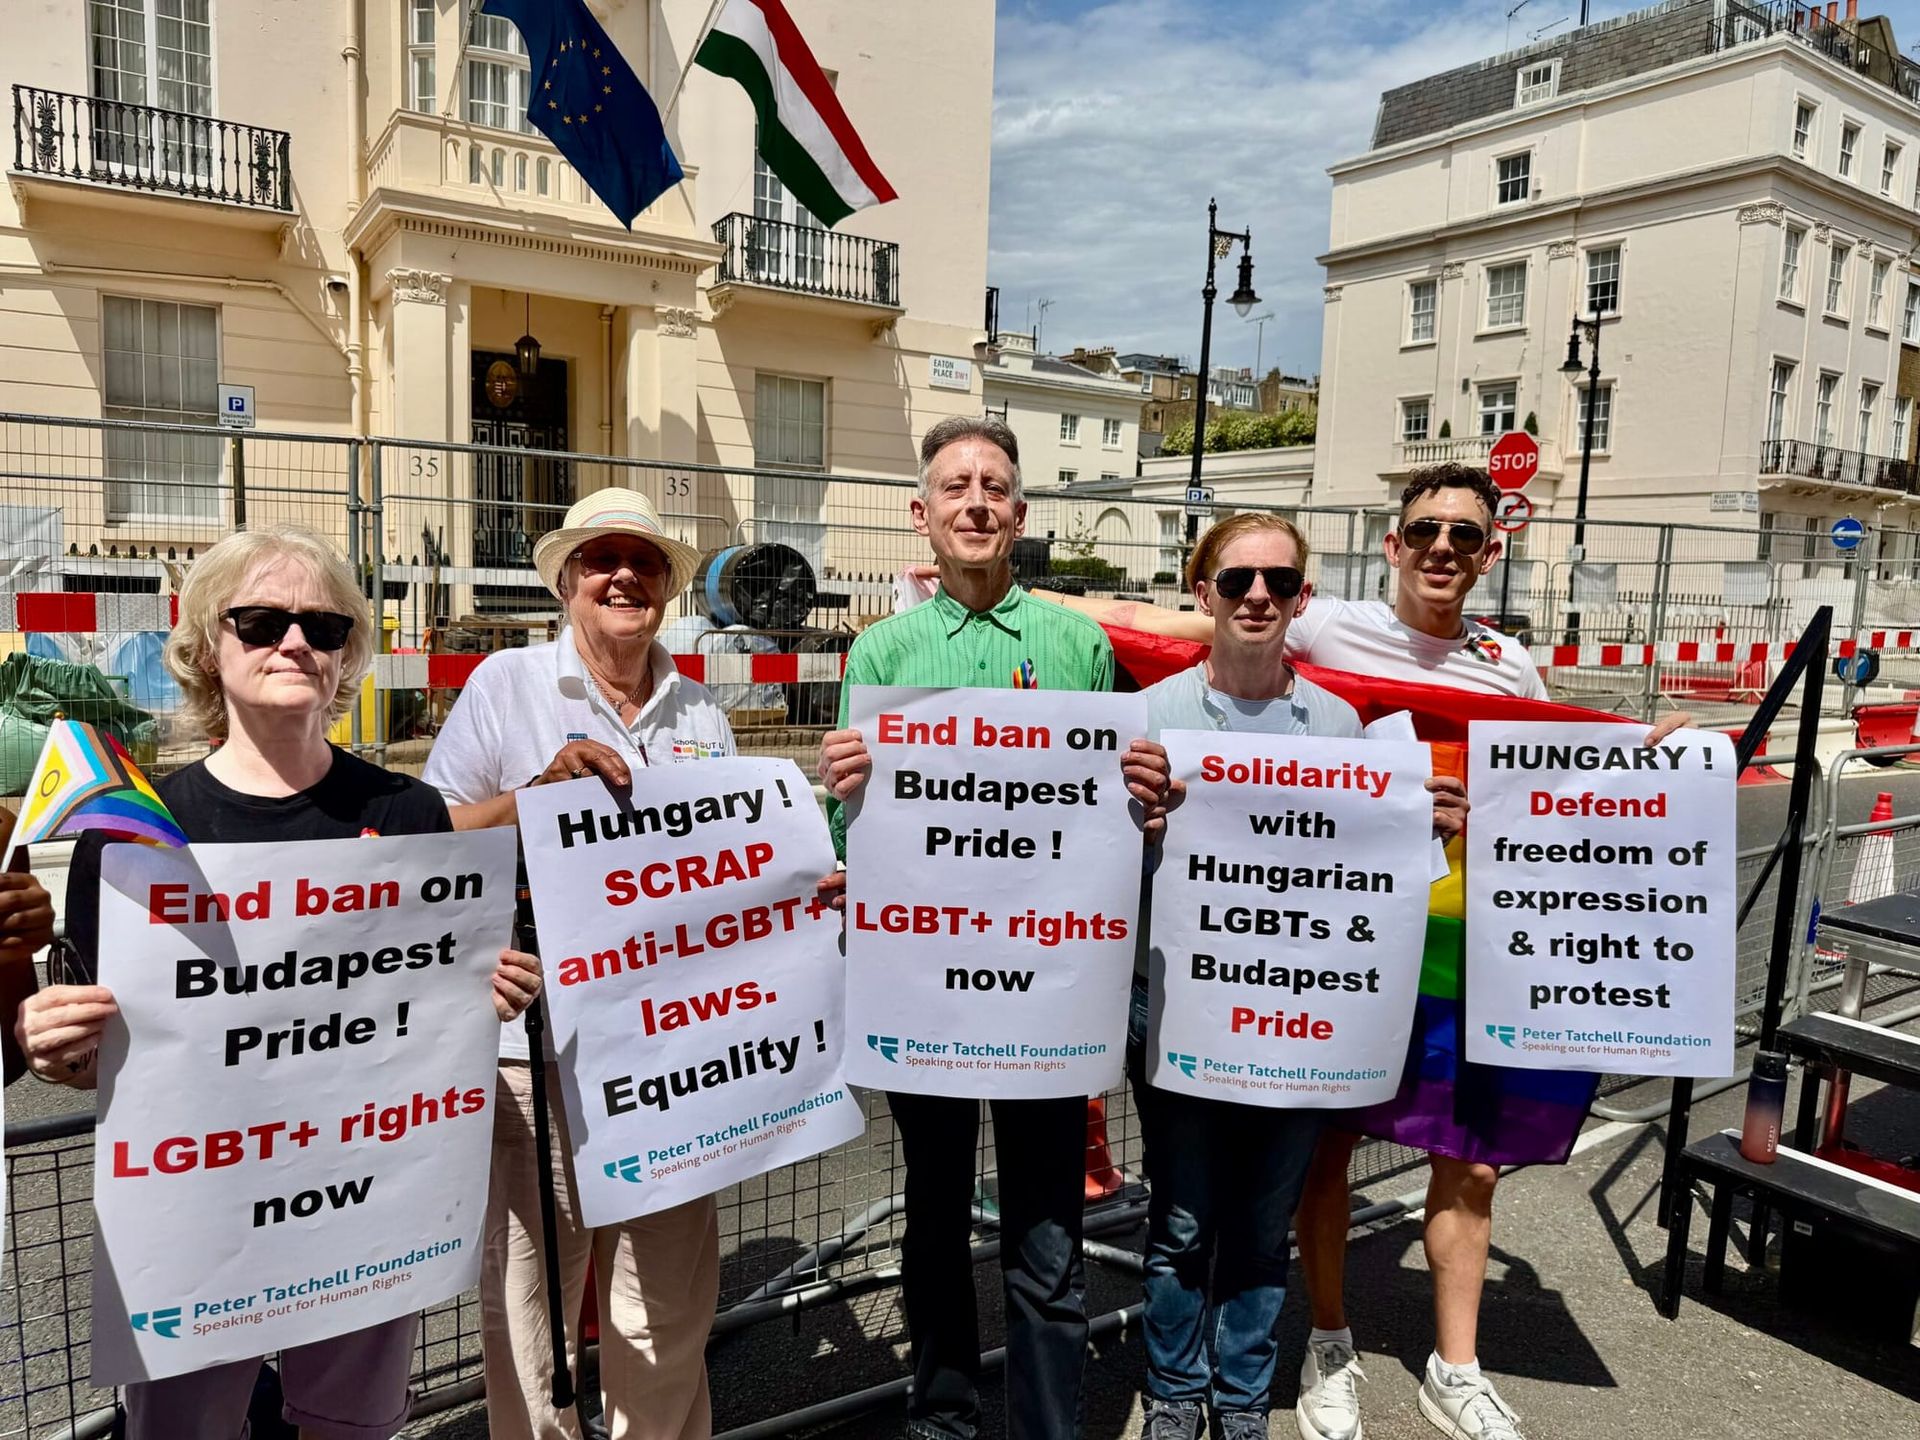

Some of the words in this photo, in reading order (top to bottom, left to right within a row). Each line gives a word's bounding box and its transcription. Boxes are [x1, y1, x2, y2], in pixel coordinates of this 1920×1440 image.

[933, 359, 954, 369] EATON
[933, 368, 953, 378] PLACE
[232, 398, 242, 410] P
[411, 456, 438, 477] 35
[1490, 452, 1537, 470] STOP
[667, 476, 690, 496] 35
[878, 714, 957, 745] End
[973, 717, 1050, 748] ban
[1067, 727, 1117, 750] on
[1490, 745, 1687, 770] HUNGARY
[1703, 747, 1713, 769] !
[895, 770, 1097, 810] Budapest
[1201, 755, 1392, 798] Solidarity
[558, 789, 764, 848] Hungary
[775, 779, 792, 808] !
[1530, 791, 1666, 817] Defend
[1250, 810, 1335, 838] with
[926, 827, 1036, 858] Pride
[1052, 831, 1062, 859] !
[1494, 837, 1652, 865] freedom
[1668, 841, 1708, 866] of
[604, 842, 774, 906] SCRAP
[1188, 854, 1393, 893] Hungarian
[149, 881, 271, 924] End
[296, 879, 400, 916] ban
[420, 872, 483, 903] on
[1493, 888, 1707, 915] expression
[856, 903, 992, 935] LGBT+
[1009, 909, 1128, 946] rights
[1200, 905, 1330, 939] LGBTs
[1347, 915, 1375, 942] &
[558, 895, 828, 987] anti-LGBT+
[1508, 931, 1535, 956] &
[1550, 932, 1639, 964] right
[1654, 936, 1693, 961] to
[176, 931, 456, 999] Budapest
[946, 968, 1034, 992] now
[1191, 954, 1379, 995] Budapest
[641, 981, 777, 1036] laws.
[1530, 981, 1670, 1009] protest
[225, 1012, 376, 1067] Pride
[397, 1001, 410, 1037] !
[1231, 1007, 1333, 1040] Pride
[1523, 1027, 1561, 1041] Peter
[1565, 1030, 1623, 1043] Tatchell
[1628, 1032, 1711, 1047] Foundation
[906, 1039, 948, 1054] Peter
[952, 1042, 1015, 1057] Tatchell
[1021, 1043, 1106, 1057] Foundation
[906, 1055, 953, 1069] Speaking
[956, 1059, 973, 1069] out
[976, 1060, 991, 1069] for
[994, 1061, 1031, 1070] Human
[1034, 1061, 1066, 1072] Rights
[1522, 1042, 1566, 1054] Speaking
[1568, 1045, 1585, 1053] out
[1587, 1045, 1600, 1054] for
[1603, 1046, 1637, 1055] Human
[1640, 1047, 1671, 1058] Rights
[603, 1035, 800, 1117] Equality
[814, 1020, 826, 1052] !
[1203, 1073, 1247, 1088] Speaking
[1250, 1080, 1266, 1089] out
[1269, 1081, 1283, 1090] for
[1286, 1082, 1319, 1092] Human
[1322, 1083, 1350, 1093] Rights
[1204, 1058, 1243, 1074] Peter
[1248, 1063, 1305, 1079] Tatchell
[1311, 1068, 1387, 1081] Foundation
[113, 1120, 319, 1178] LGBT+
[341, 1086, 485, 1143] rights
[648, 1142, 692, 1165] Peter
[696, 1117, 758, 1149] Tatchell
[762, 1089, 843, 1127] Foundation
[650, 1155, 700, 1179] Speaking
[702, 1150, 720, 1161] out
[723, 1143, 737, 1155] for
[739, 1131, 774, 1150] Human
[777, 1117, 807, 1136] Rights
[253, 1176, 374, 1228] now
[194, 1293, 256, 1319] Peter
[262, 1269, 349, 1304] Tatchell
[355, 1237, 462, 1280] Foundation
[193, 1310, 263, 1335] Speaking
[267, 1305, 292, 1318] out
[296, 1298, 316, 1312] for
[320, 1285, 368, 1305] Human
[372, 1271, 412, 1292] Rights
